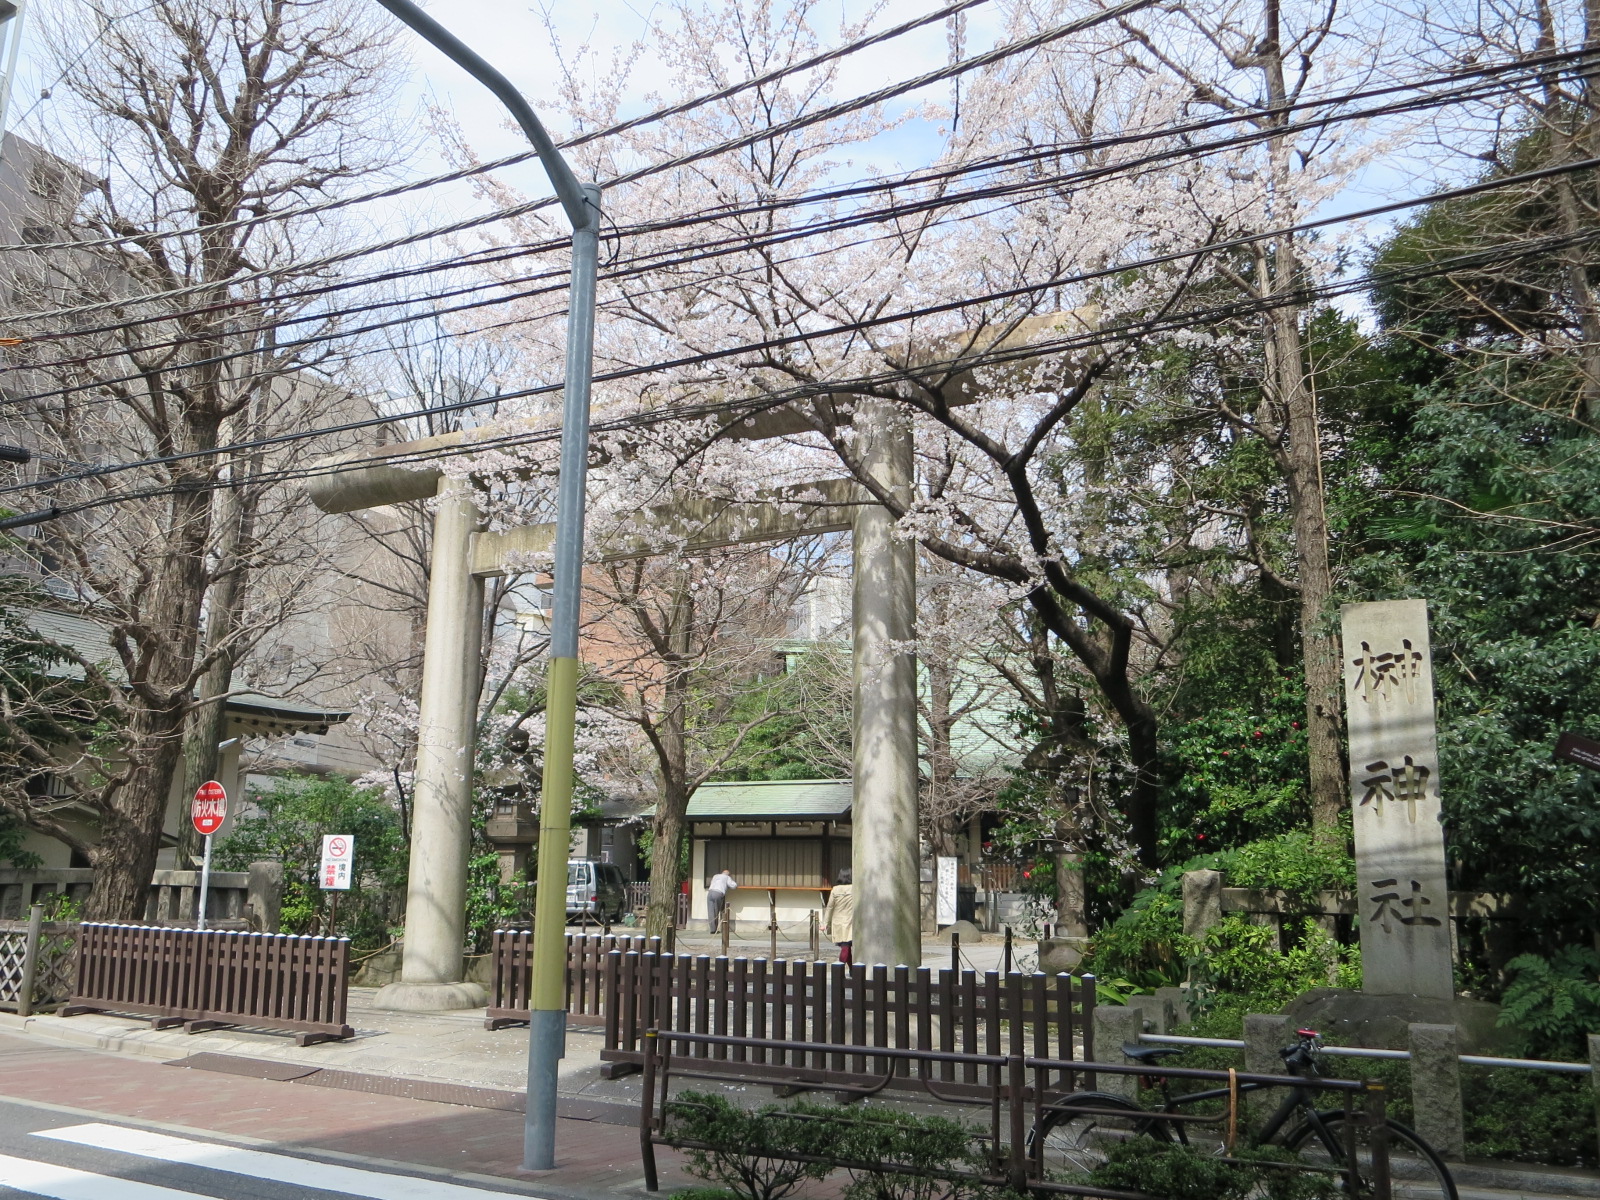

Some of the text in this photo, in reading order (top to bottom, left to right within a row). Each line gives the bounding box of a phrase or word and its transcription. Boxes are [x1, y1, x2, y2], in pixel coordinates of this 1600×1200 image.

[1353, 638, 1442, 934] 榊神社
[325, 864, 336, 887] 禁煙
